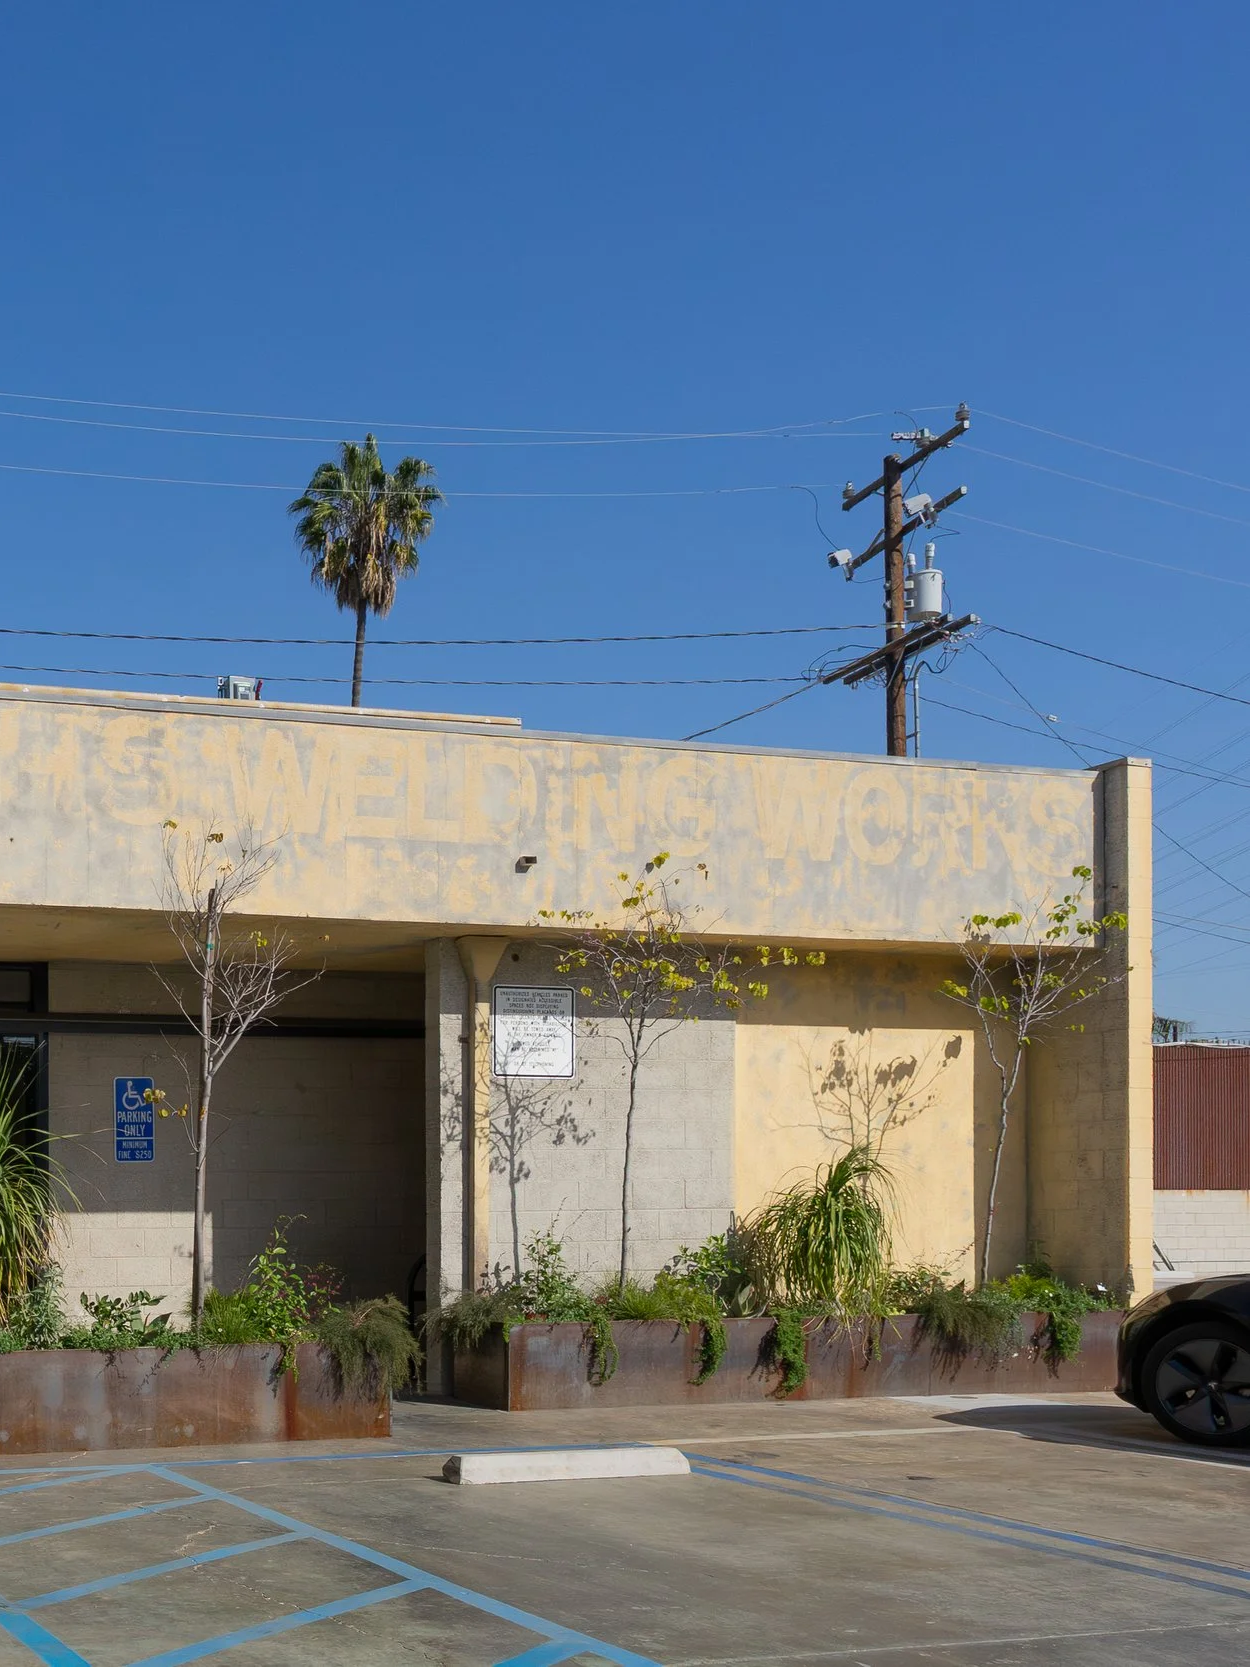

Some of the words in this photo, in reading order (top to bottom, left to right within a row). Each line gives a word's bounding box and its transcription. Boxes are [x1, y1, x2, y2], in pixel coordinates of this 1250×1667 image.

[224, 722, 718, 858] WELDING
[117, 1110, 152, 1123] PARKING
[124, 1124, 146, 1137] ONLY
[122, 1140, 148, 1149] MINIMUM
[118, 1150, 131, 1159] FINE
[135, 1150, 152, 1159] $250
